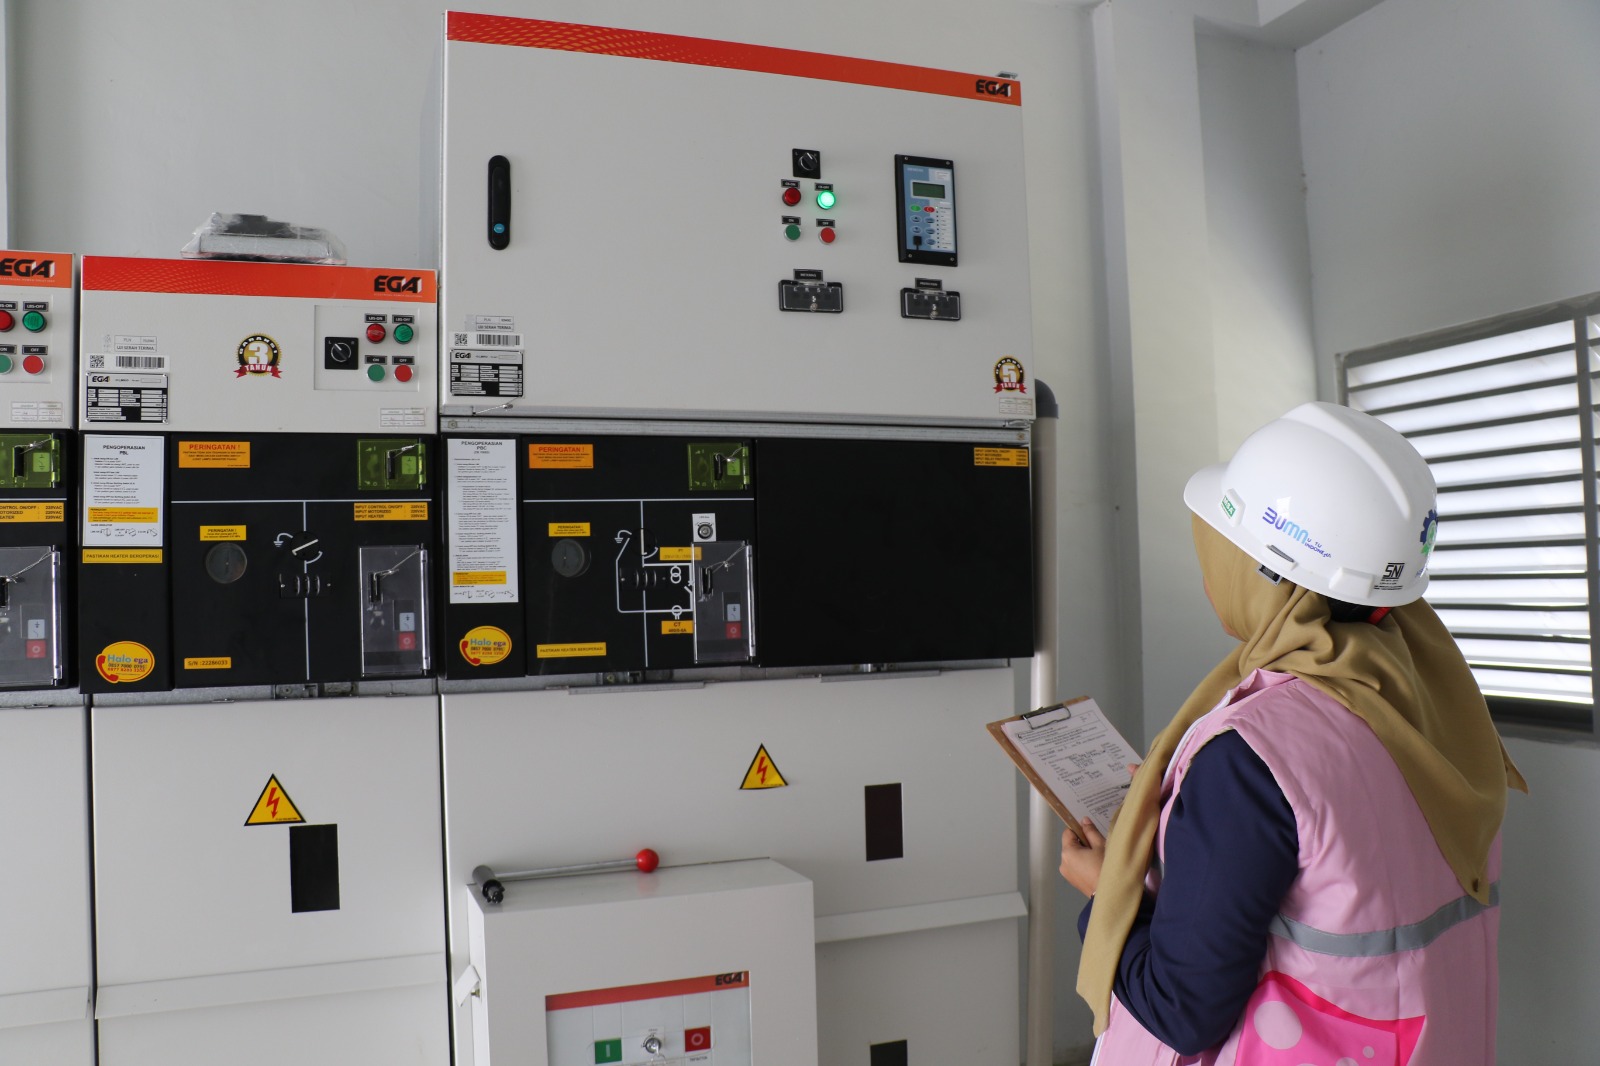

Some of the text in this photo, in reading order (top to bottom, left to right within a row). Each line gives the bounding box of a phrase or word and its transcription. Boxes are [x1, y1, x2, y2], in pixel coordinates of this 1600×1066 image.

[976, 79, 1011, 97] EGA
[0, 258, 55, 278] EGA
[374, 275, 422, 293] EGA
[248, 342, 269, 364] 3
[1002, 364, 1017, 382] 5
[1382, 563, 1404, 579] SNI
[108, 654, 132, 663] Halo
[714, 971, 744, 986] EGA
